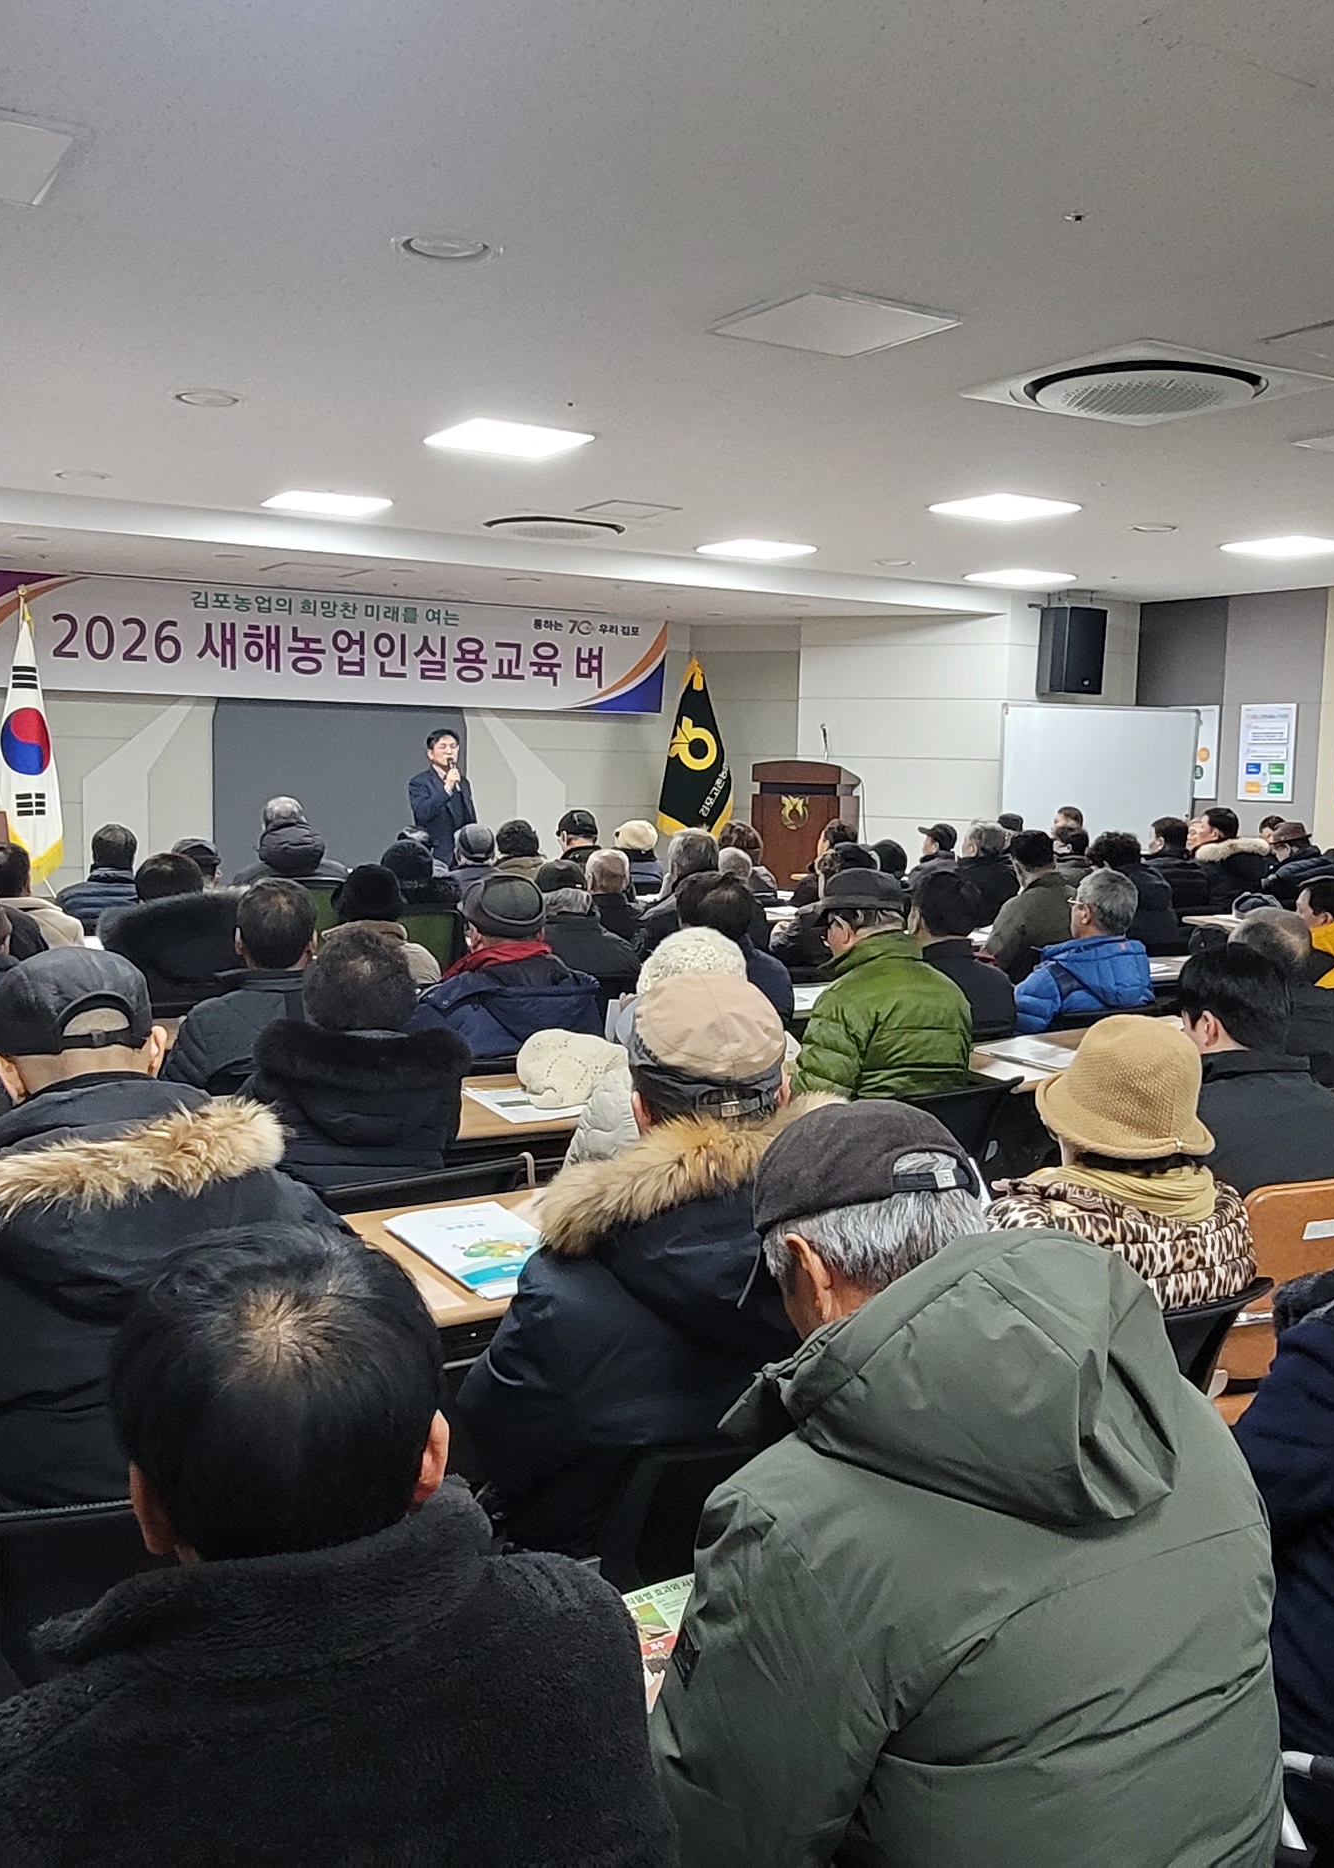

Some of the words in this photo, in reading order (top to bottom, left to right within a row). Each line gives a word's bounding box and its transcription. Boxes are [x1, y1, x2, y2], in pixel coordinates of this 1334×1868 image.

[190, 590, 293, 614] 김포농업의
[300, 599, 357, 619] 희망찬
[364, 603, 418, 623] 미래를
[425, 607, 460, 627] 여는
[533, 618, 563, 631] 통하는
[598, 624, 618, 635] 우리
[621, 625, 640, 636] 김포
[51, 613, 182, 664] 2026
[196, 621, 562, 687] 새해농업인실용교육
[575, 645, 605, 688] 벼
